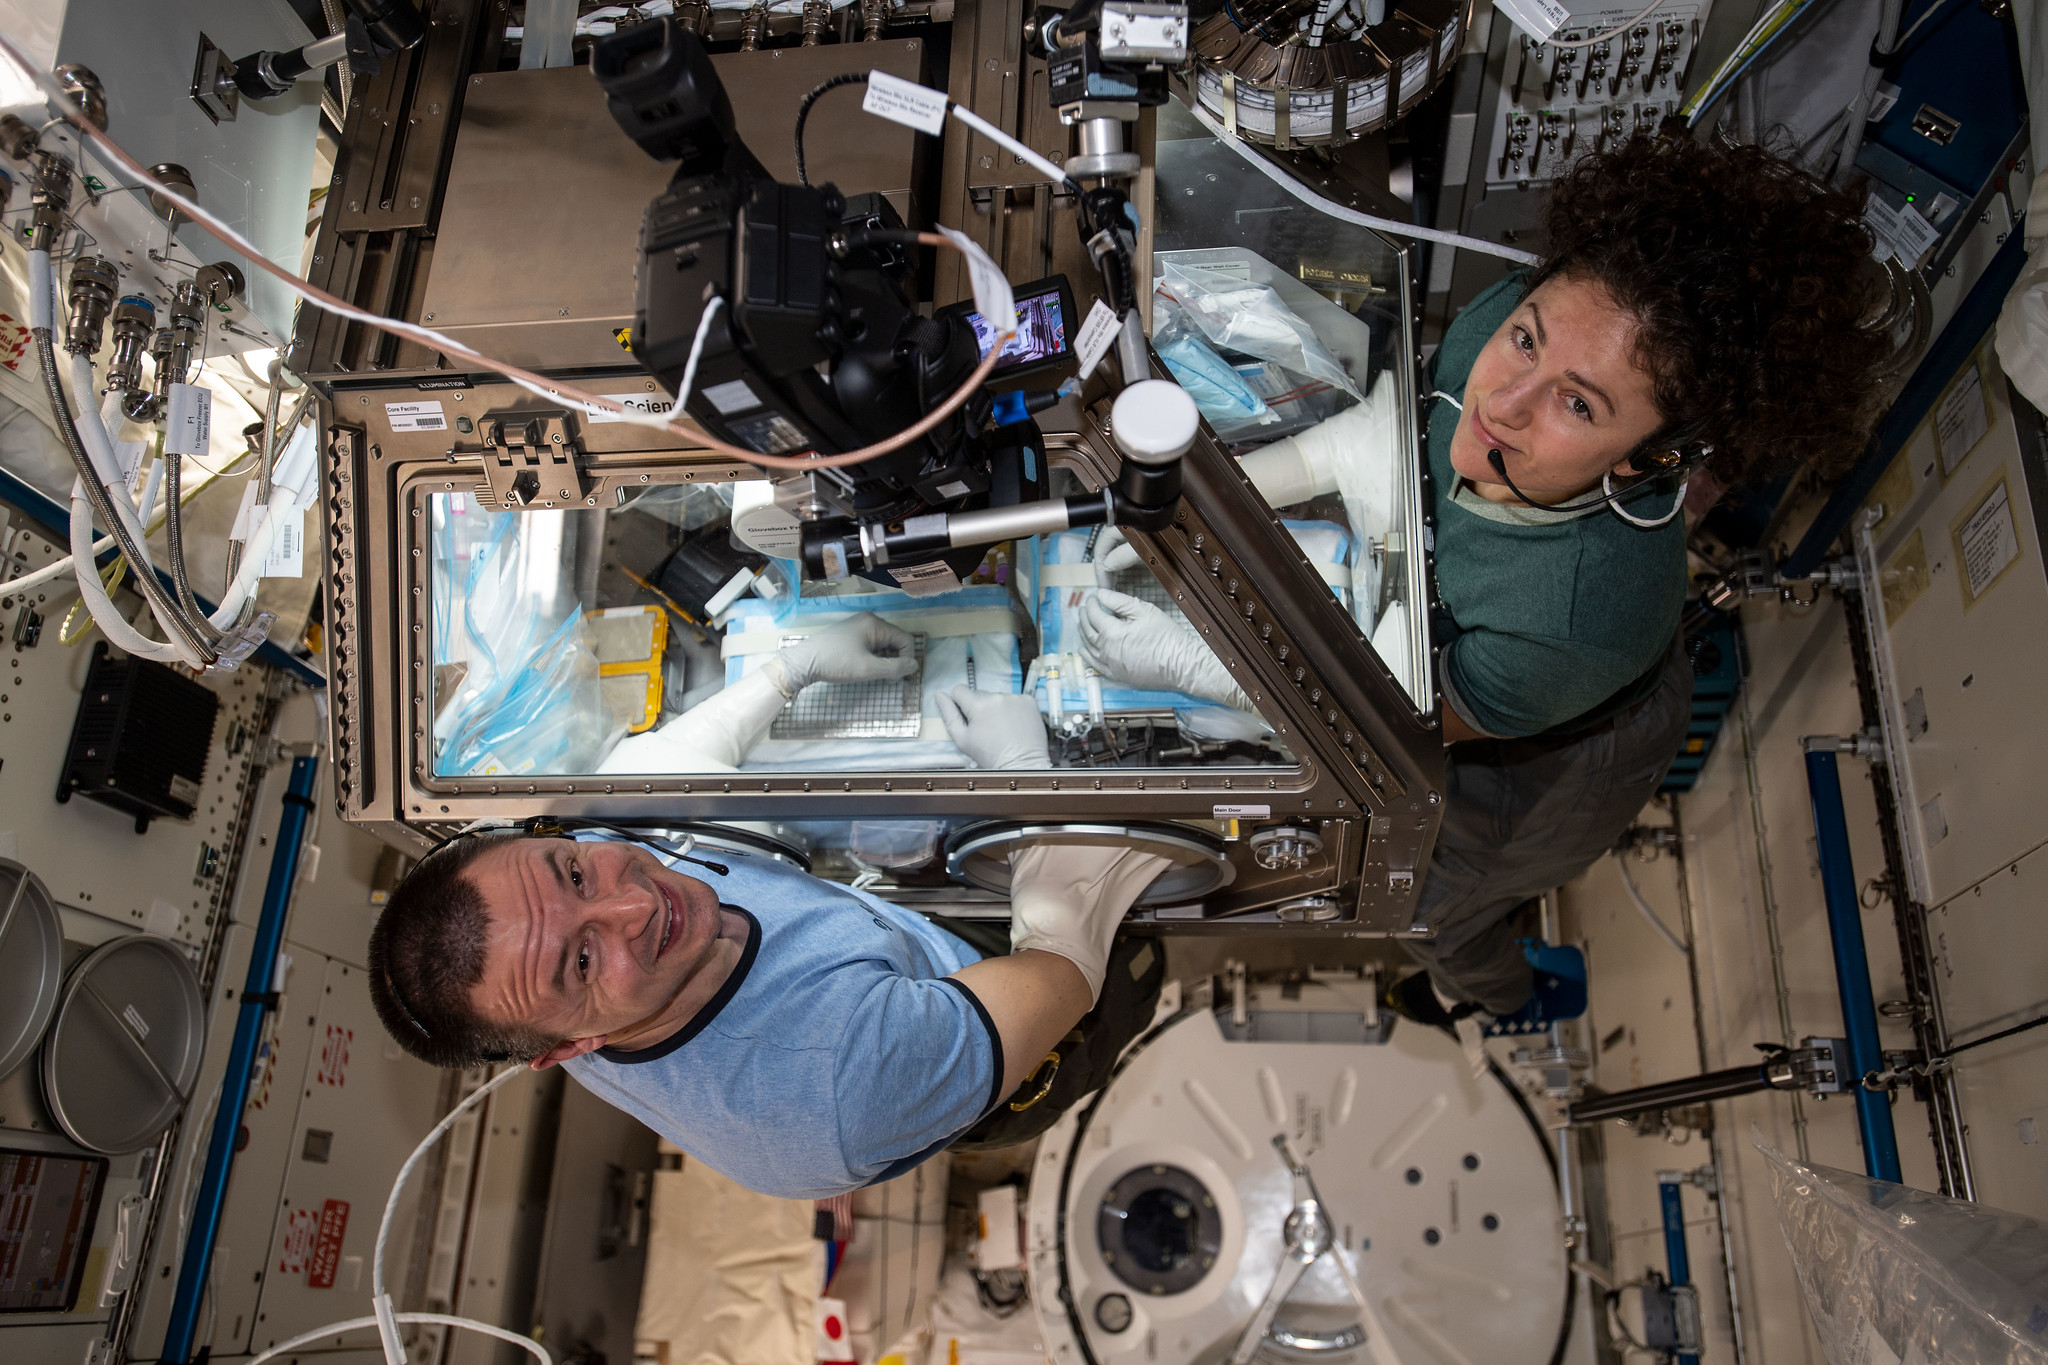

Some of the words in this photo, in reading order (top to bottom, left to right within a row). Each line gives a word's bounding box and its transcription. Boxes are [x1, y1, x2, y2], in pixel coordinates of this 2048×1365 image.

[1553, 6, 1564, 16] USB
[418, 380, 466, 389] ILLUMINATION
[313, 1210, 334, 1276] WATER
[321, 1244, 338, 1285] MIST
[332, 1204, 346, 1237] PFE
